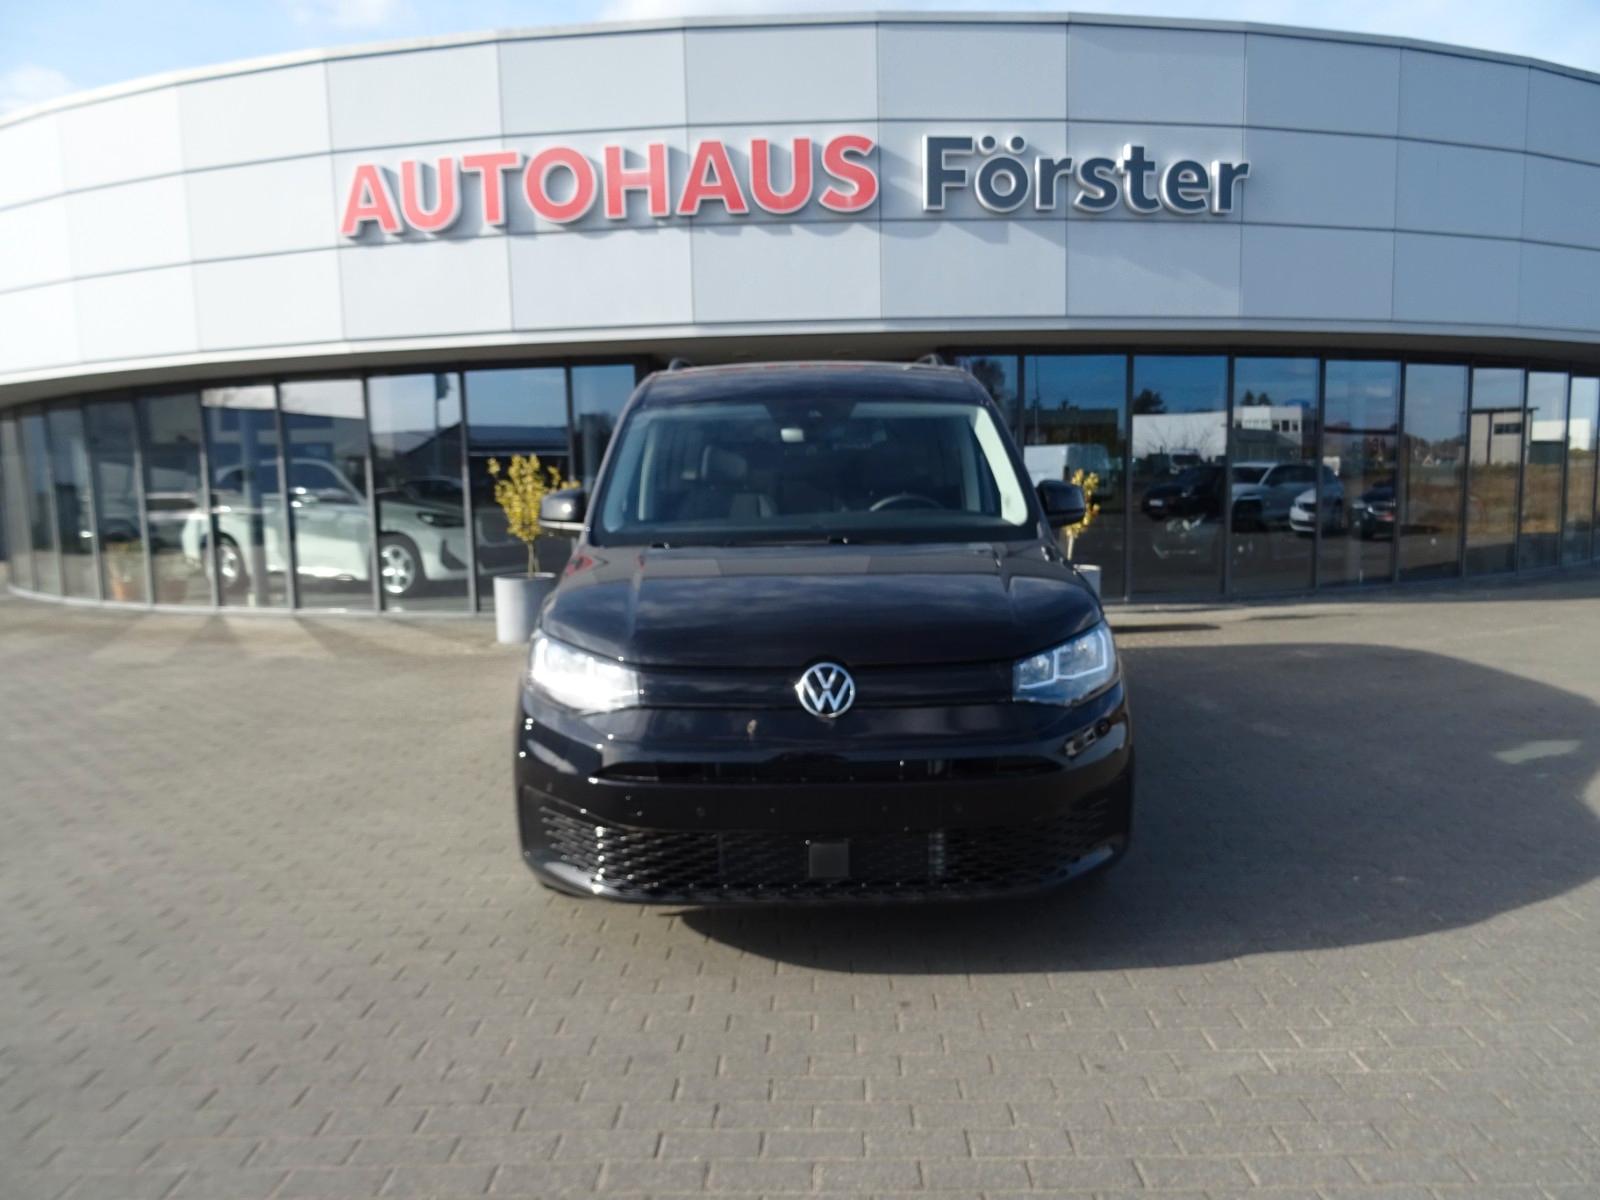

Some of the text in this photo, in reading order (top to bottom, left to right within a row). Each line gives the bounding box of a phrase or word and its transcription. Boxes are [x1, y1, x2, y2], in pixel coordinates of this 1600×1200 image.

[341, 134, 1249, 236] AUTOHAUS Förster
[796, 662, 855, 718] VW
